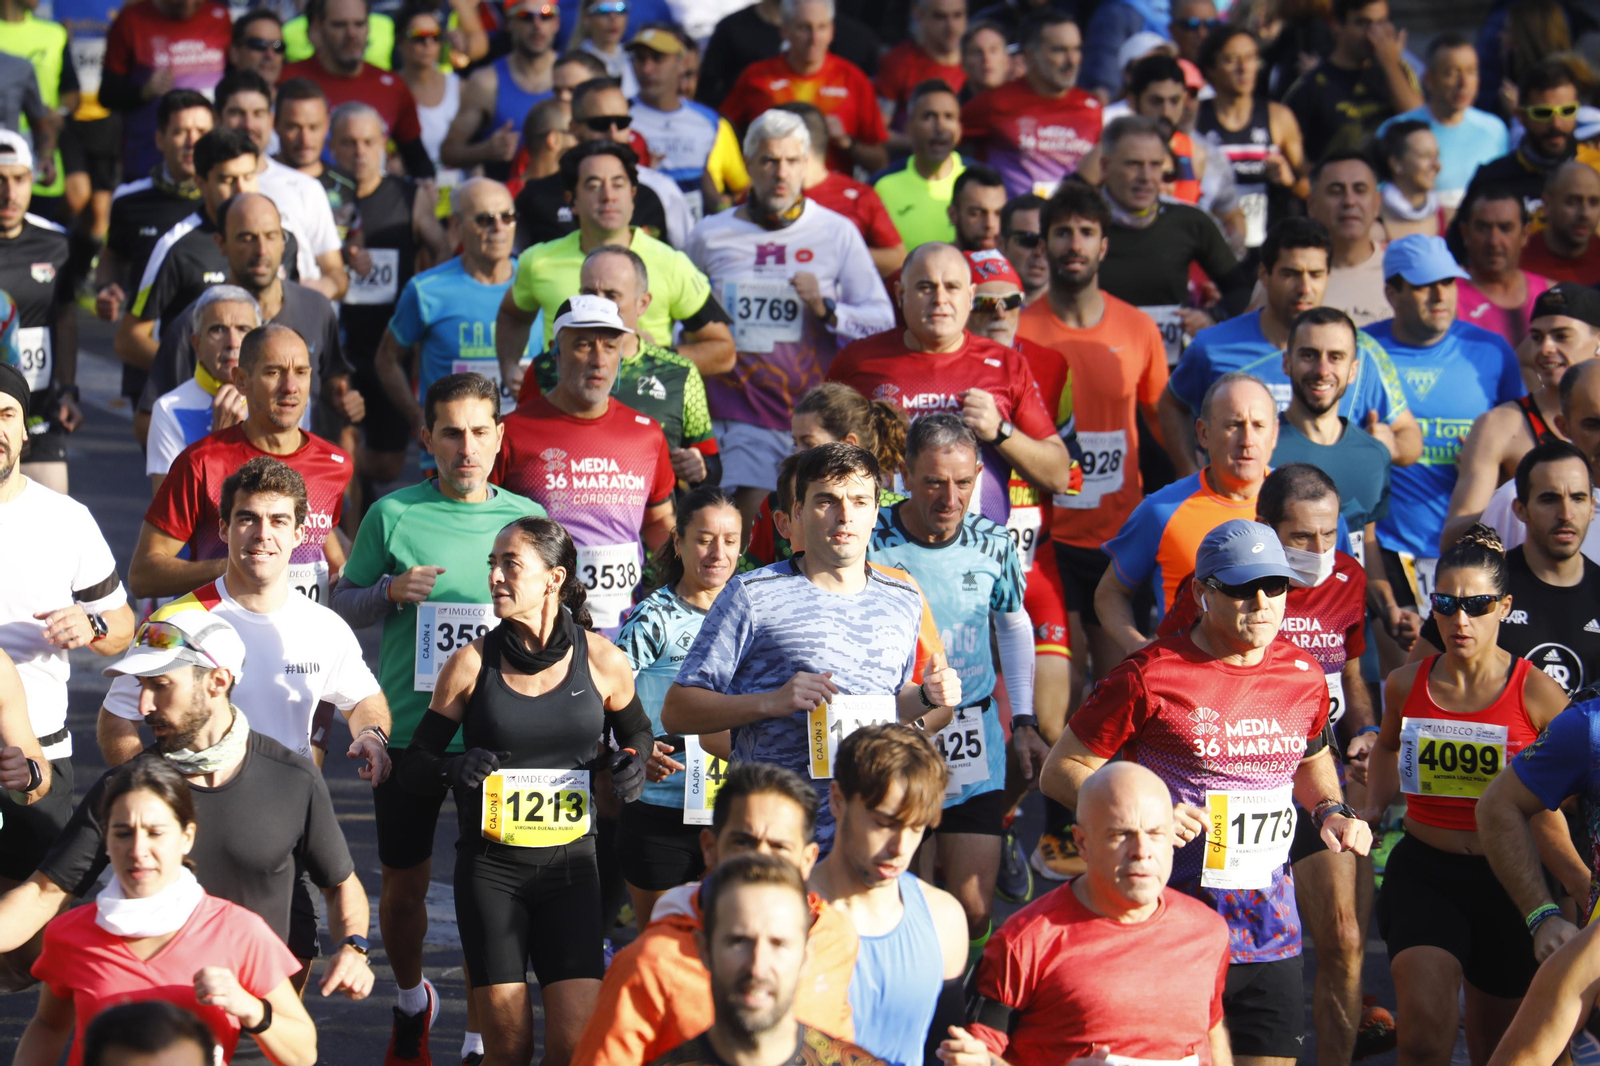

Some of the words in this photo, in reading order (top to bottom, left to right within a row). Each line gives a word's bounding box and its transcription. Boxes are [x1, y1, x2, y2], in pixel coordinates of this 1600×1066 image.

[738, 297, 798, 322] 3769
[22, 348, 46, 370] 39
[903, 393, 959, 409] MEDIA
[570, 458, 620, 473] MEDIA
[1082, 449, 1122, 475] 928
[545, 473, 568, 490] 36
[573, 471, 645, 490] MARATÓN
[573, 491, 626, 504] CÓRDOBA
[289, 570, 311, 578] DECO
[583, 563, 637, 591] 3538
[449, 607, 486, 617] IMDECO
[1279, 617, 1322, 631] MEDIA
[422, 630, 430, 659] CAJÓN
[1285, 629, 1345, 648] ARATÓN
[1225, 718, 1283, 738] MEDIA
[1433, 725, 1473, 736] IMDECO
[814, 729, 823, 760] CAJÓN
[1193, 738, 1221, 757] 36
[1227, 731, 1308, 757] MARATÓN
[1225, 758, 1285, 775] CÓRDOBA
[1405, 748, 1413, 778] CAJÓN
[1418, 741, 1499, 775] 4099
[517, 775, 558, 784] IMDECO
[692, 766, 700, 794] CAJÓN
[506, 791, 583, 822] 1213
[1243, 794, 1279, 804] IMDECO
[489, 800, 498, 830] CAJÓN
[1231, 807, 1293, 845] 1773
[1213, 822, 1222, 853] CAJÓN
